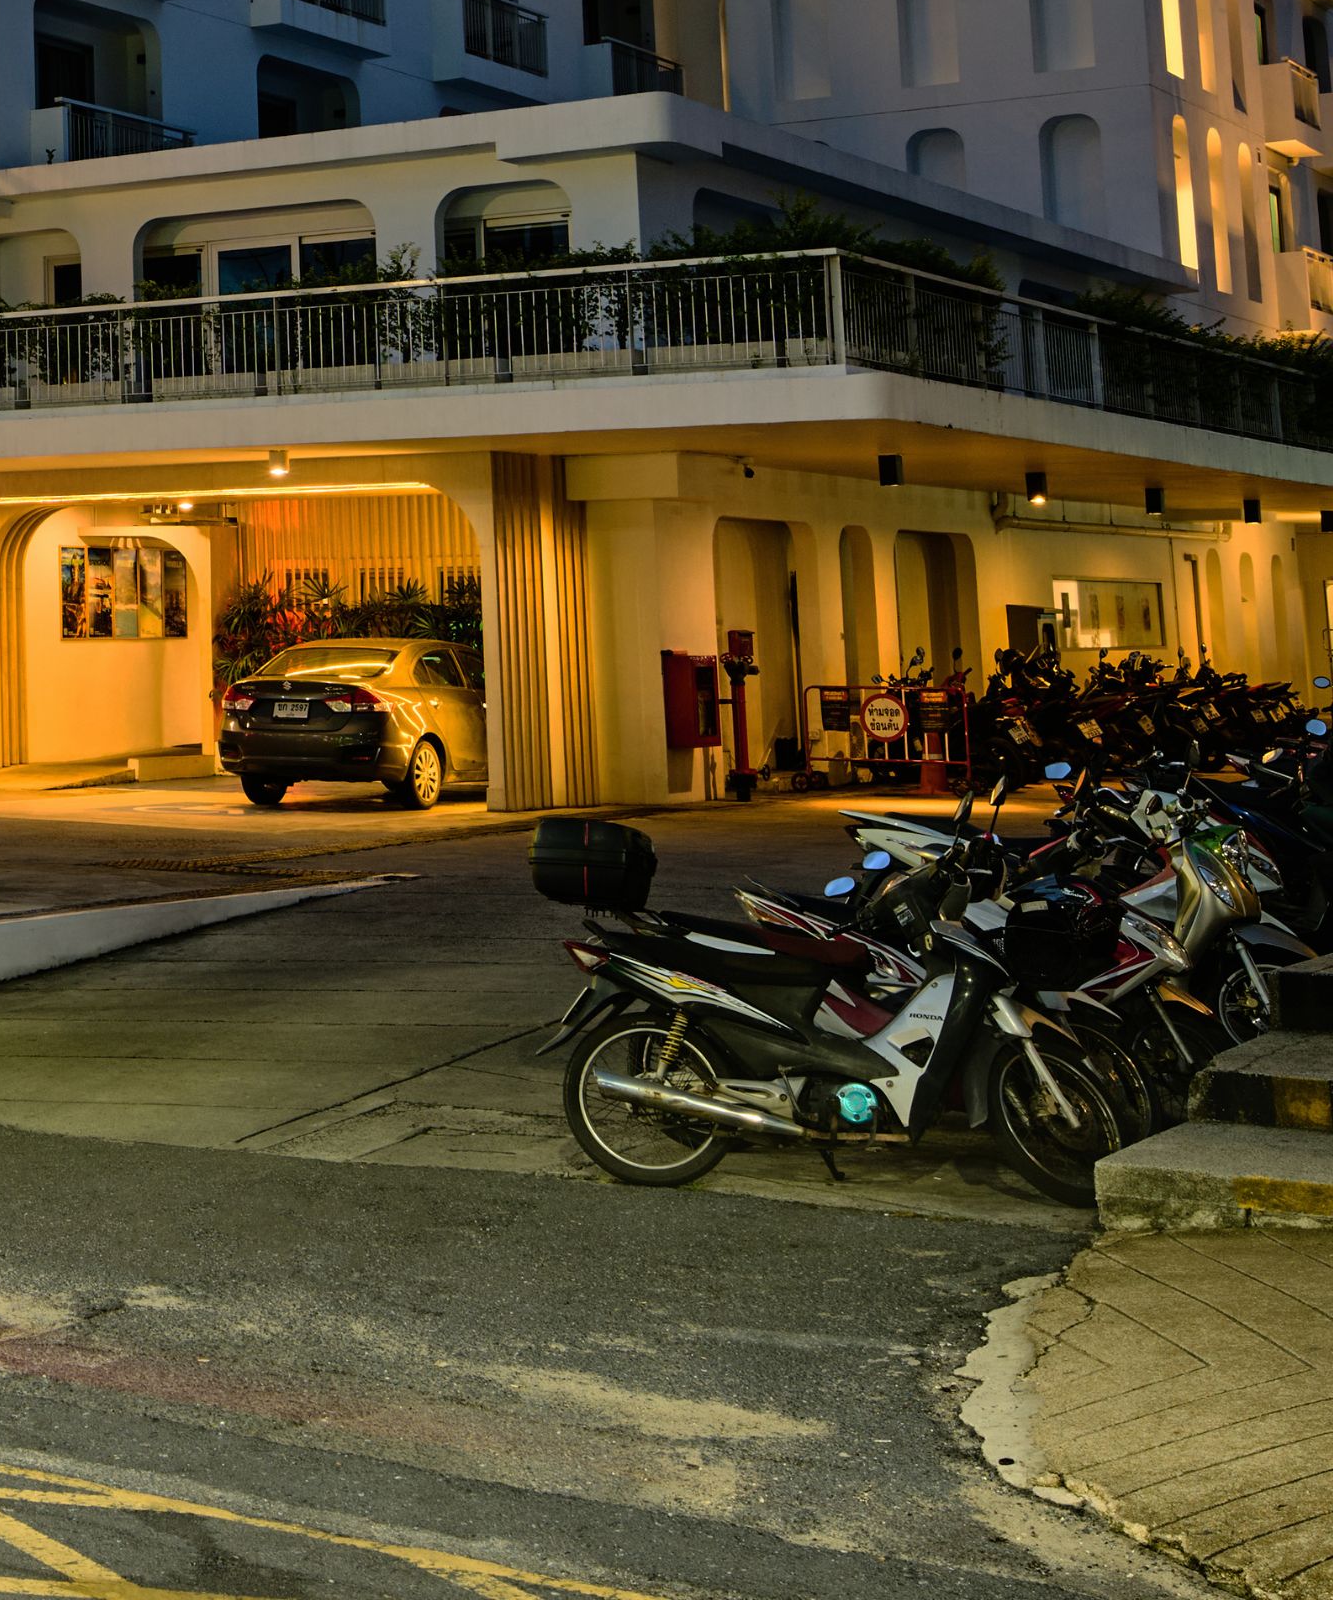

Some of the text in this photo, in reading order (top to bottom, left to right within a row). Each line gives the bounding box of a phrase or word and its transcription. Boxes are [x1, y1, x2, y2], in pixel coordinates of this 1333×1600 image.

[290, 702, 308, 711] 2597
[868, 704, 900, 717] ห้ามจอด
[870, 718, 900, 732] ซ้อนคัน
[909, 1012, 944, 1021] HONDA
